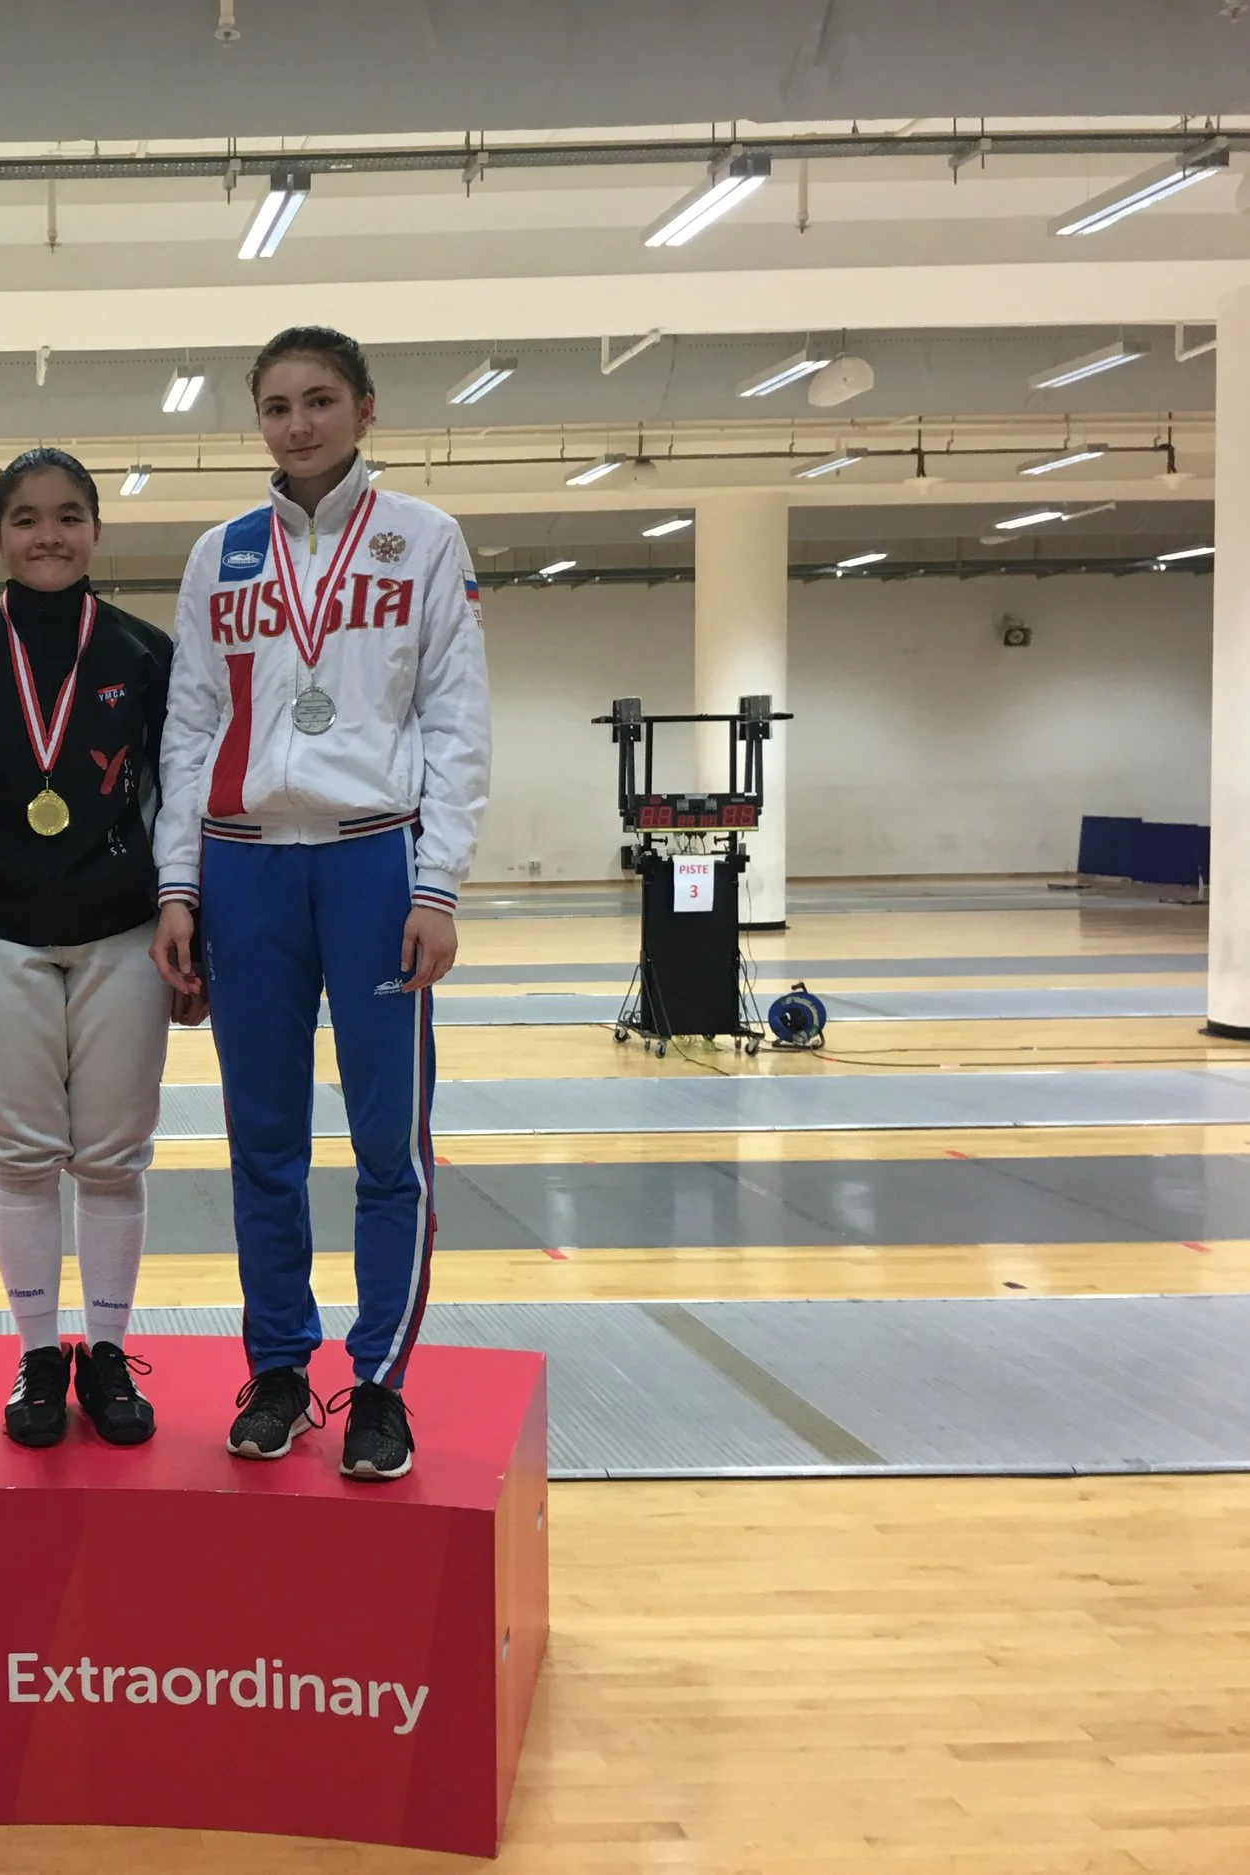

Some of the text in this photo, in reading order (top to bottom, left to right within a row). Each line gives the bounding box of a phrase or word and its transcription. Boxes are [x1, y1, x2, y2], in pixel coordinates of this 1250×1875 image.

[98, 689, 125, 702] YMCA
[679, 864, 709, 875] PISTE
[689, 884, 699, 899] 3
[7, 1652, 430, 1735] Extraordinary
